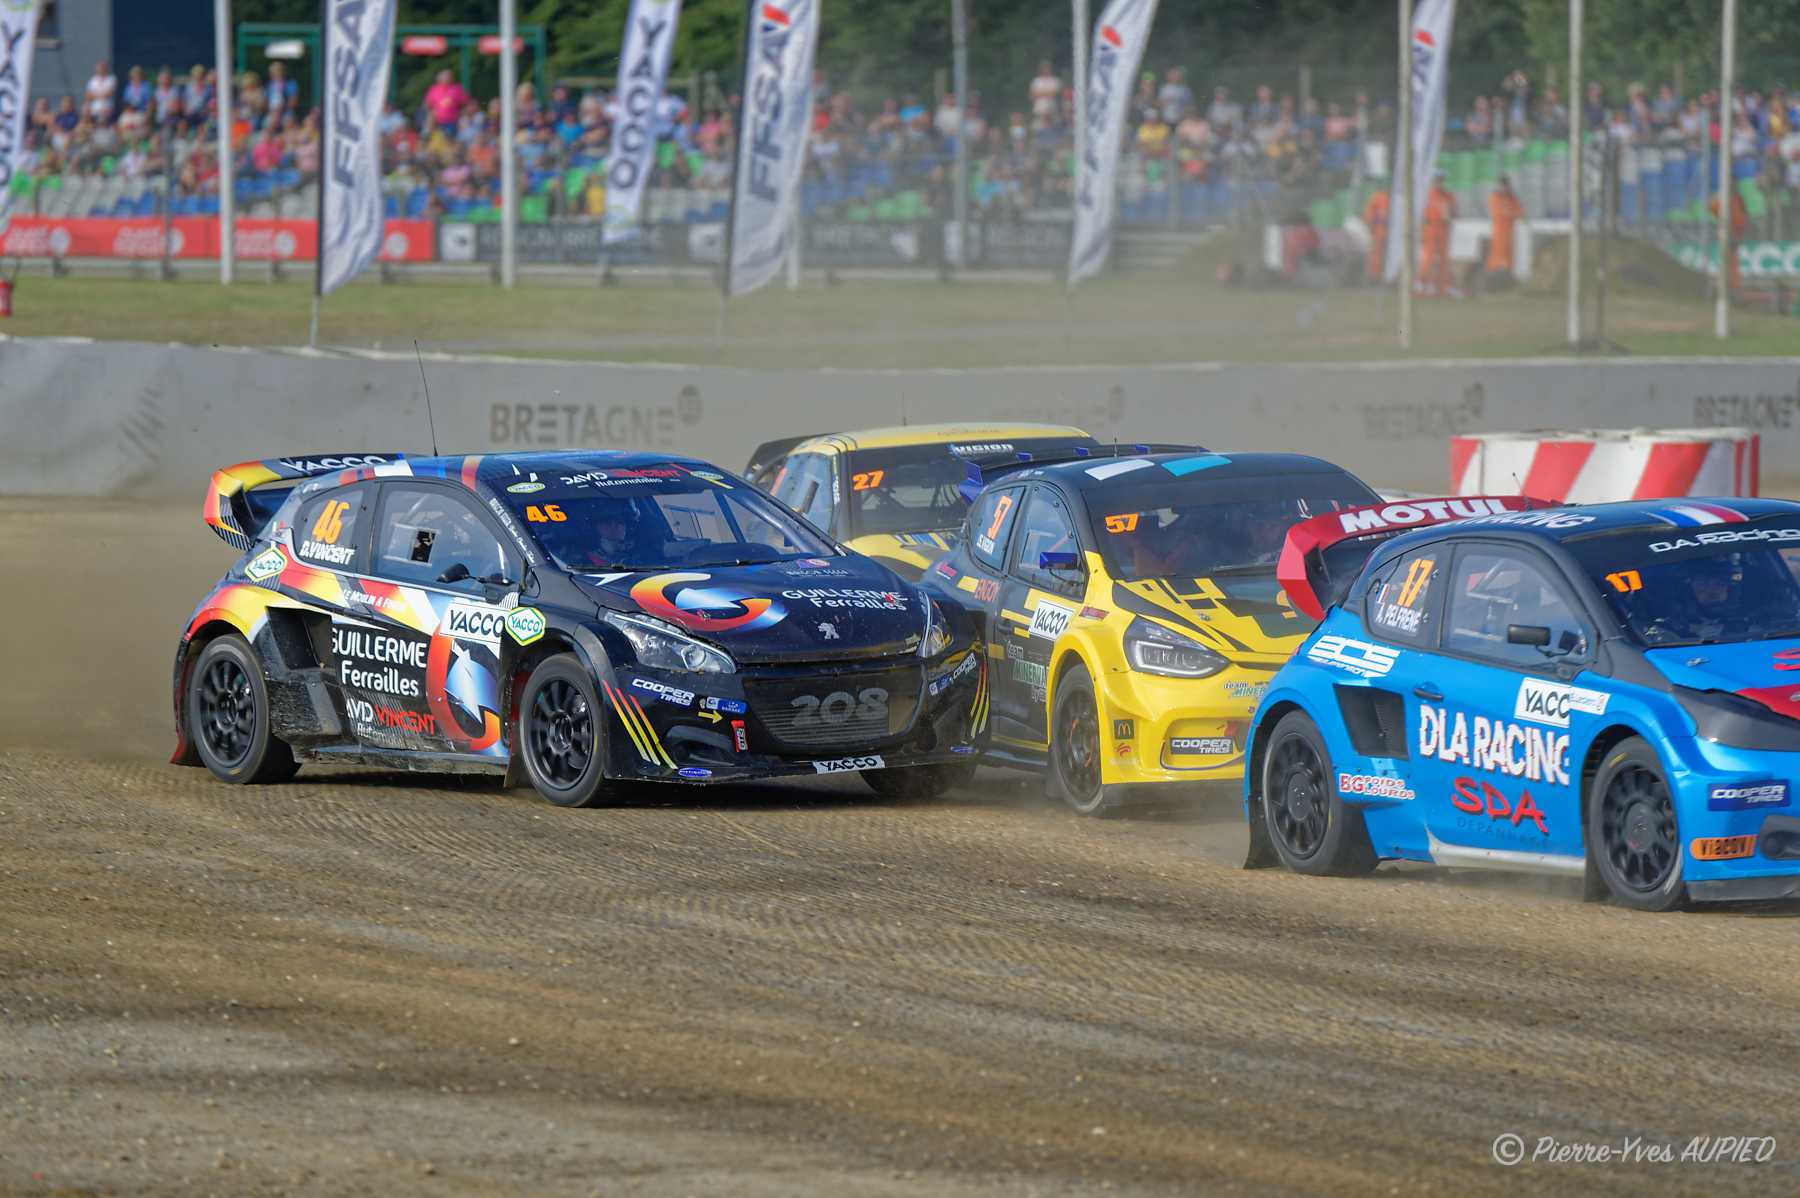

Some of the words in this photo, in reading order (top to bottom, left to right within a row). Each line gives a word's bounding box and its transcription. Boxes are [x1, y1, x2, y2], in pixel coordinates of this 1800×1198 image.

[334, 1, 366, 188] FFSA
[606, 17, 663, 191] YACCO
[749, 31, 790, 202] FFSA
[488, 403, 674, 446] BRETAGNE
[560, 472, 608, 485] DAVID
[853, 470, 884, 490] 27
[312, 500, 350, 544] 46
[526, 504, 568, 522] 46
[1105, 513, 1140, 533] 57
[1340, 499, 1518, 534] MOTUL
[300, 540, 355, 565] D.VINCENT
[1396, 559, 1434, 608] 17
[1605, 570, 1643, 592] 17
[782, 588, 908, 601] GUILLERME
[810, 597, 907, 611] Ferrailles
[450, 610, 506, 637] YACCO
[511, 617, 540, 632] YACCO
[1034, 608, 1066, 635] YACCO
[341, 661, 419, 697] Ferrailles
[632, 679, 695, 700] COOPER
[660, 694, 693, 706] TIRES
[791, 688, 888, 729] 208
[374, 704, 435, 736] VINCENT
[1170, 738, 1232, 749] COOPER
[1419, 704, 1471, 765] DLA
[1473, 716, 1569, 786] RACING
[820, 757, 877, 771] YACCO
[1711, 785, 1785, 799] COOPER
[1451, 776, 1549, 835] SDA
